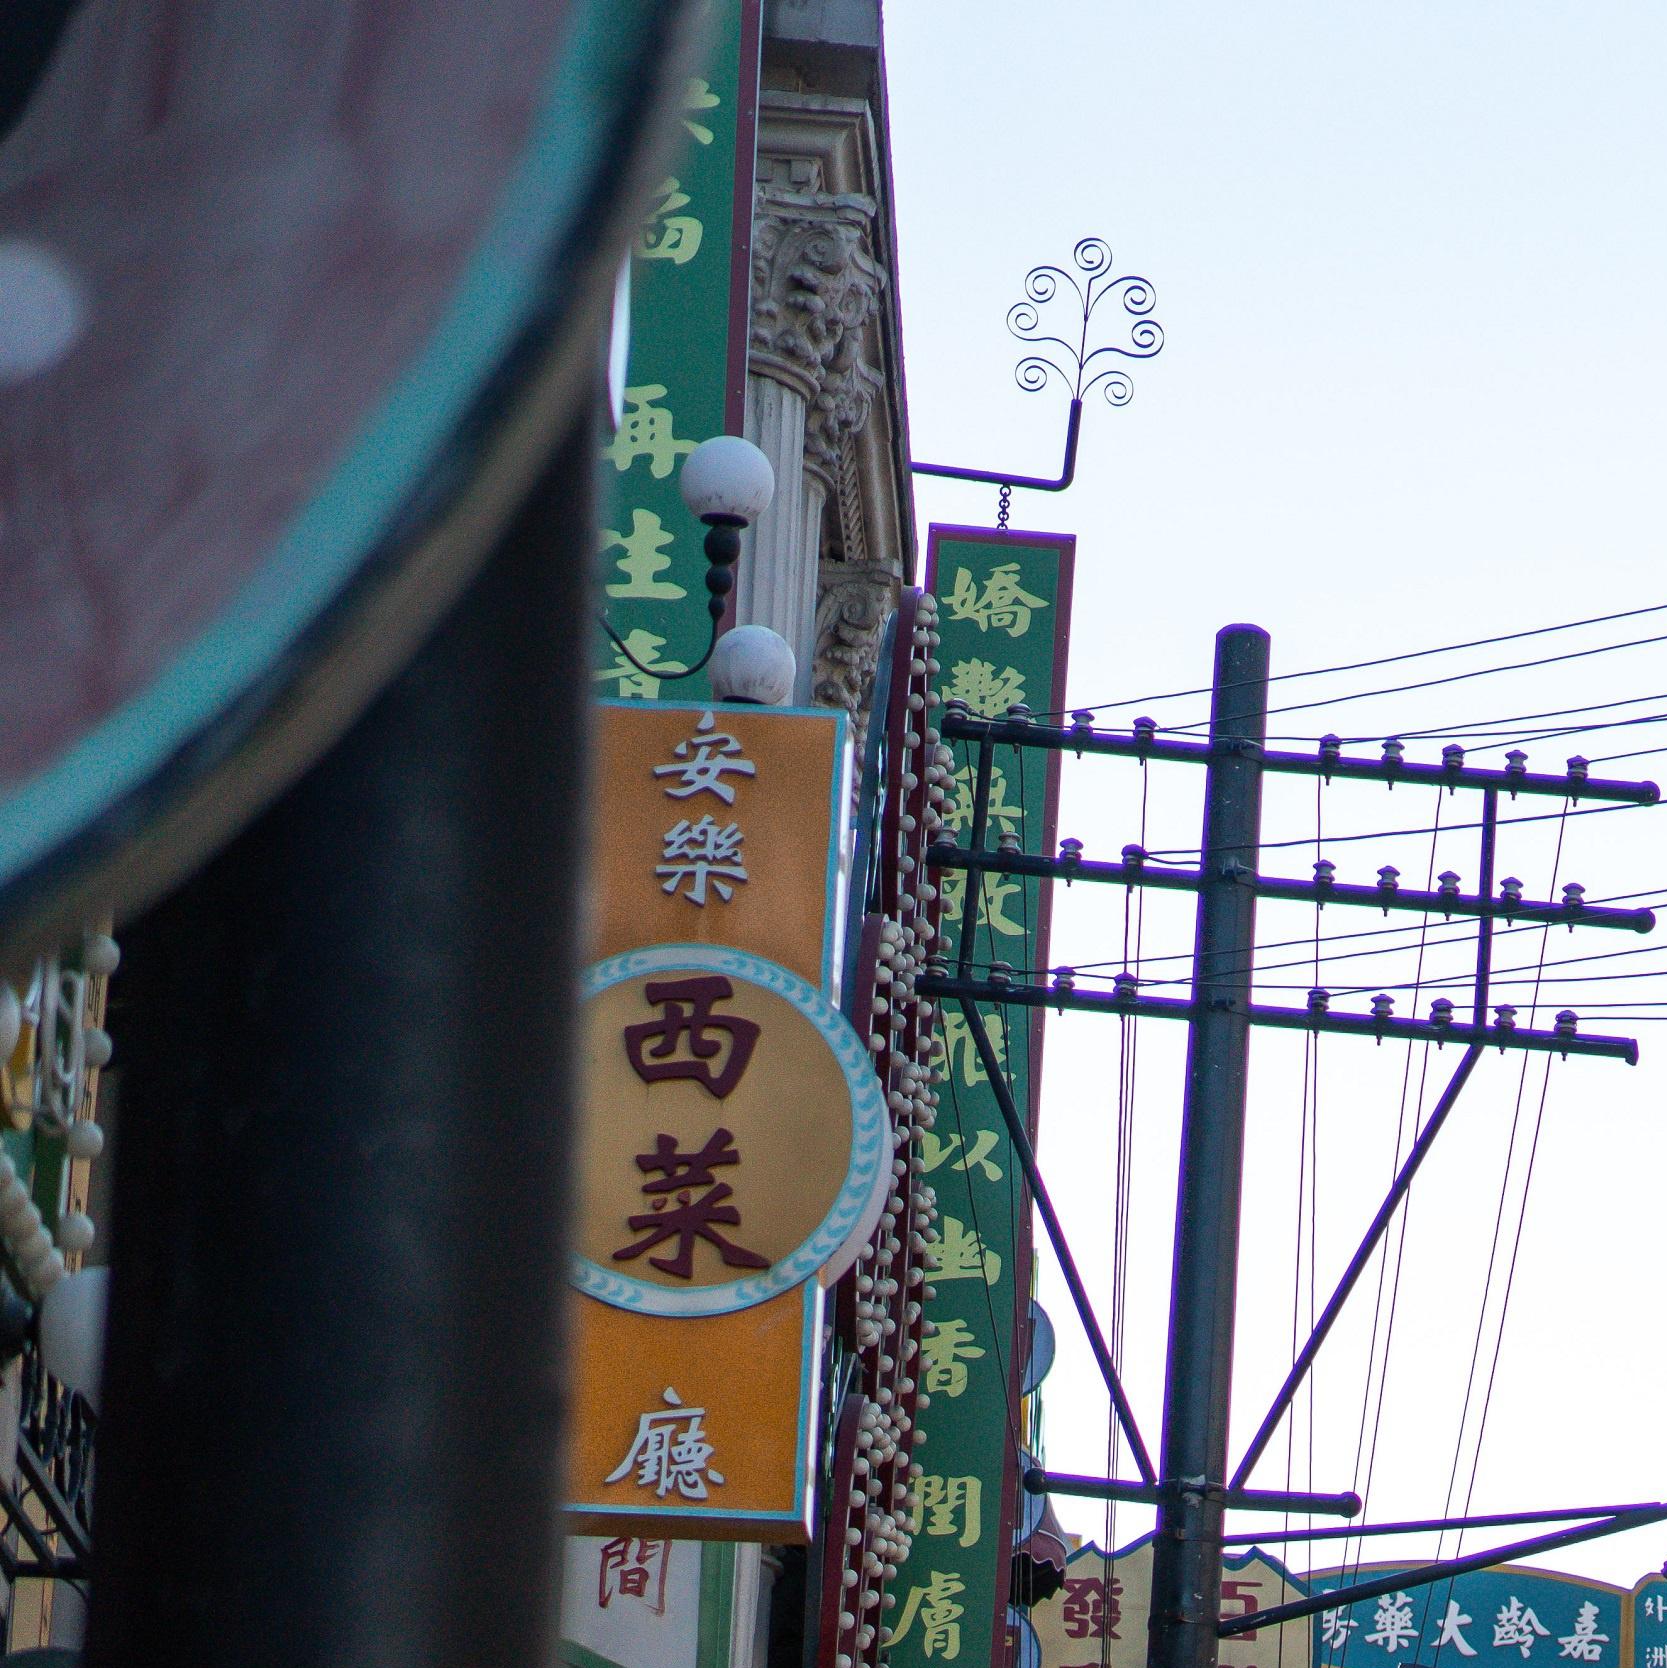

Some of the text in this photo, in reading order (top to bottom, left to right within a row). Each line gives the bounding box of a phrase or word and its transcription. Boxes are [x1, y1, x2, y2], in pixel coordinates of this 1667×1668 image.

[605, 711, 770, 1500] 安樂 西菜 廳
